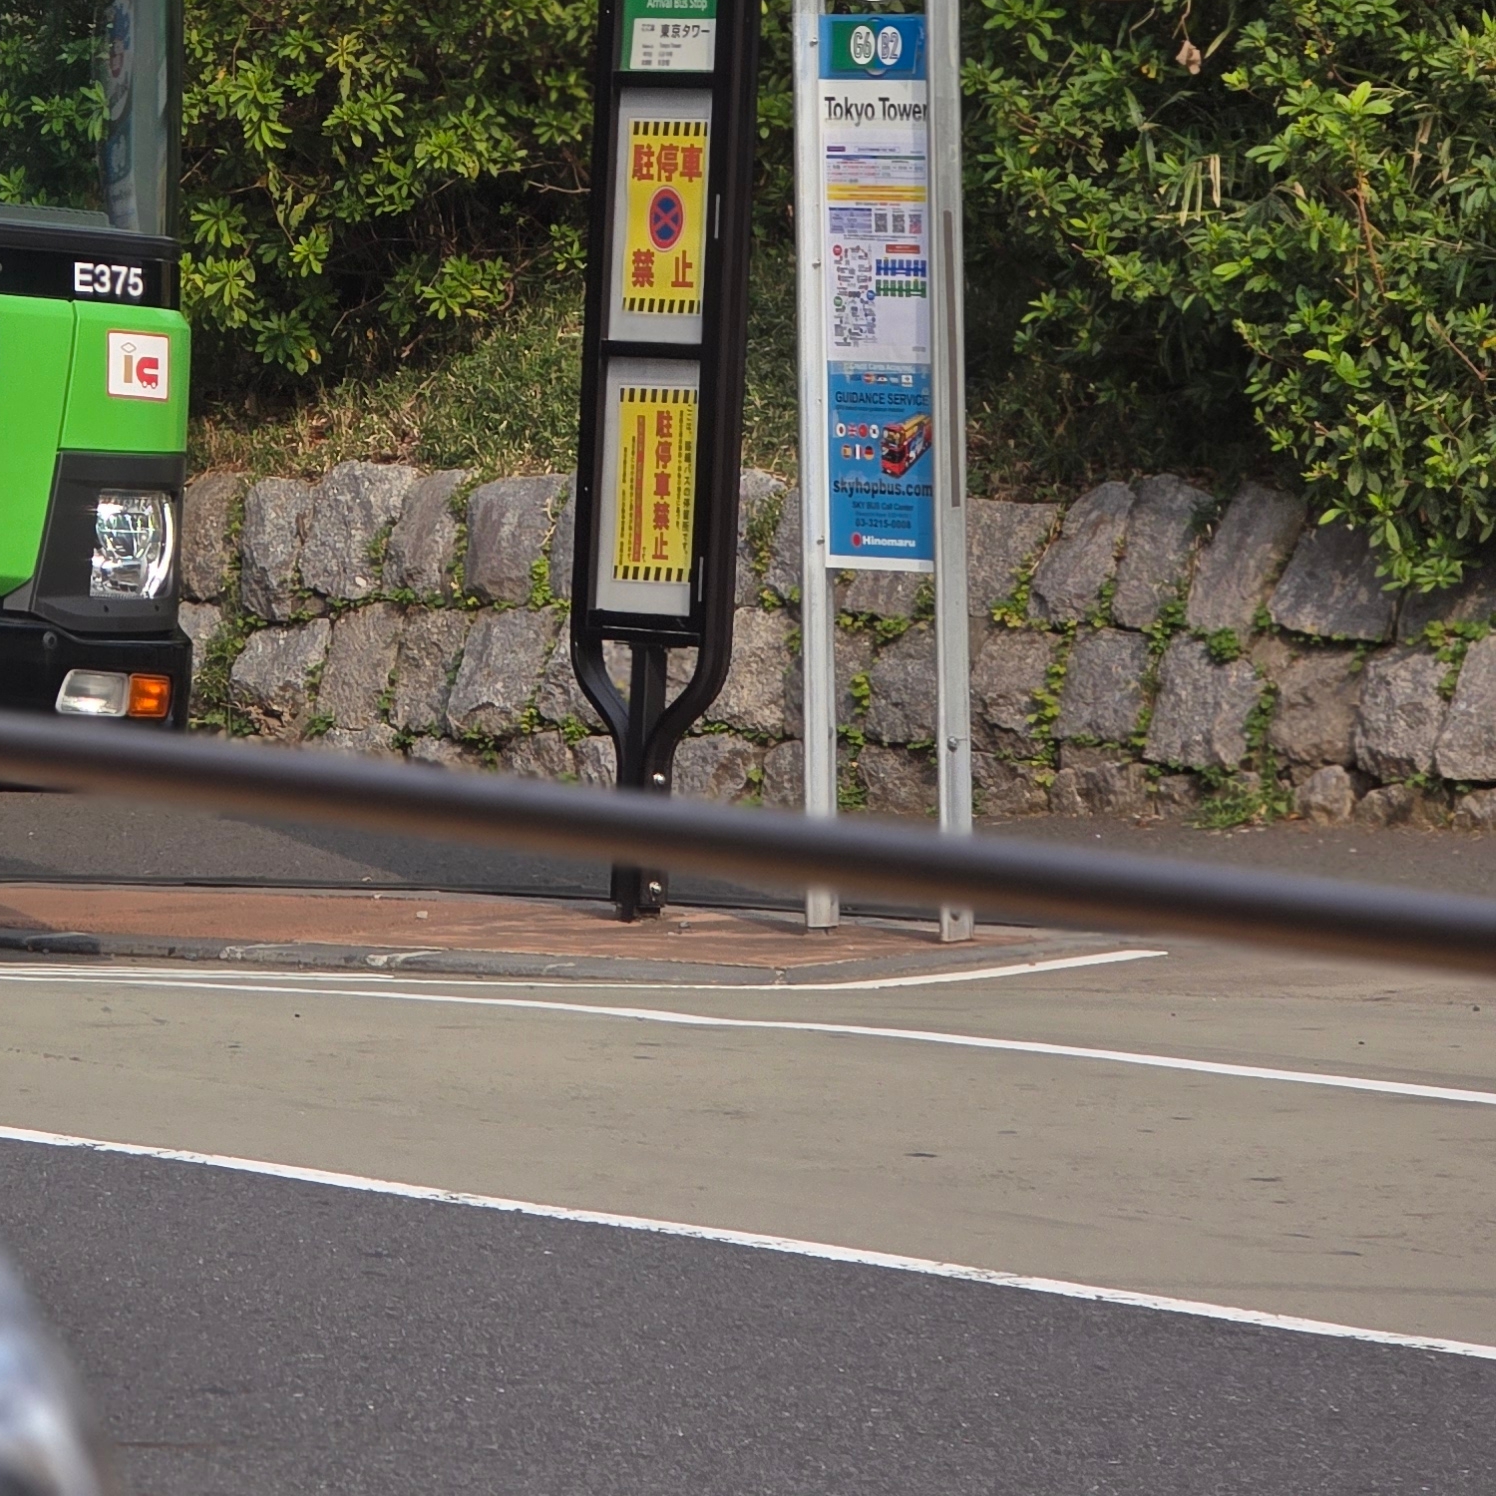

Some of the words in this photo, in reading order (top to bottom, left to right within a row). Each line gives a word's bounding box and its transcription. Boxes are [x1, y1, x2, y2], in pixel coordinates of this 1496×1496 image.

[660, 24, 710, 39] 東京タワー
[824, 96, 875, 127] Tokyo
[878, 97, 928, 122] Tower
[632, 143, 703, 182] 駐停車
[74, 262, 144, 297] E375
[632, 248, 694, 288] 禁止
[835, 391, 886, 405] GUIDANCE
[887, 392, 929, 406] SERVICE
[652, 410, 673, 560] 駐停車禁止
[833, 477, 934, 499] skyhopbus.com
[862, 535, 916, 548] Hinomaru
